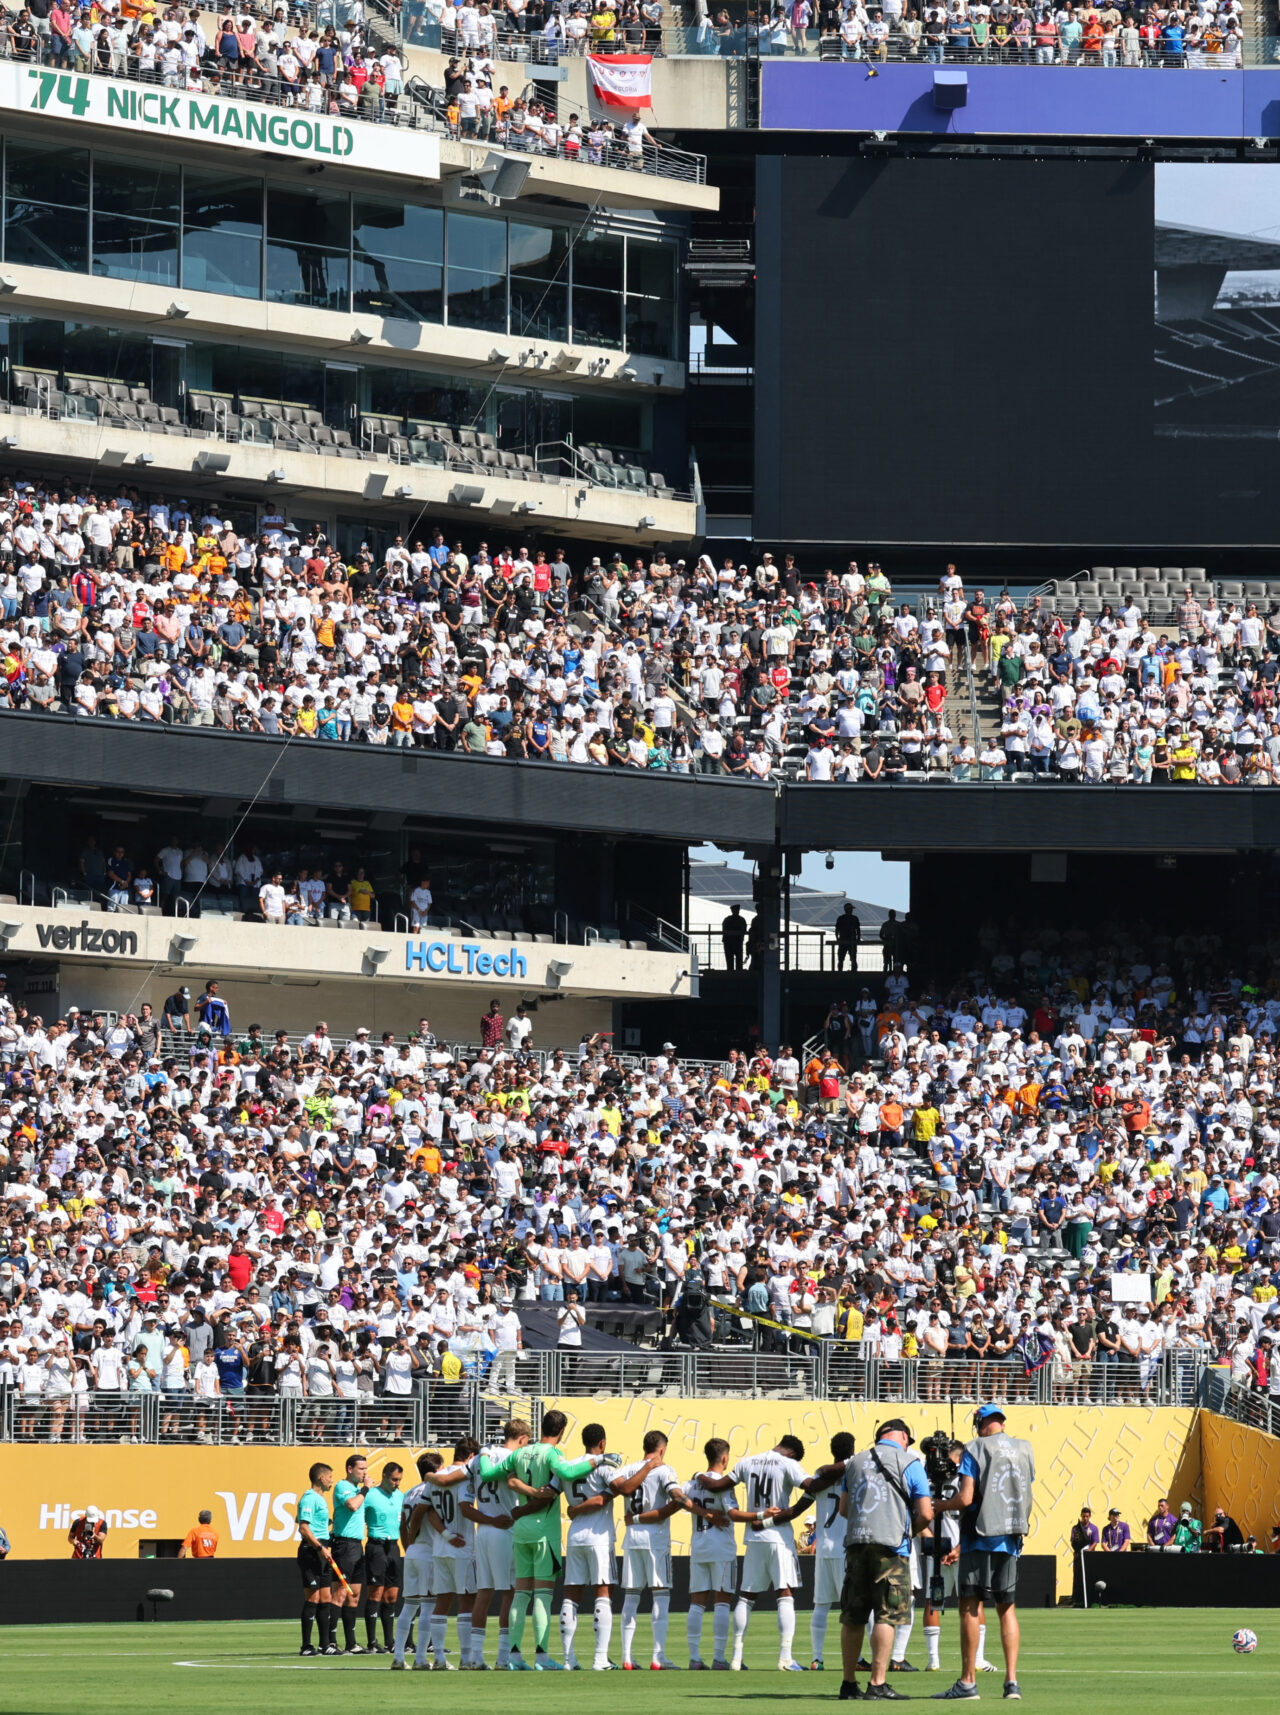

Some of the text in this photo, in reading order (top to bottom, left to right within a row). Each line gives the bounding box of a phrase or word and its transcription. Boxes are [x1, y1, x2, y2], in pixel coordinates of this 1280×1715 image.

[28, 69, 355, 157] 74 NICK MANGOLD
[36, 920, 138, 955] verizon
[405, 940, 528, 977] HCLTech
[1000, 1449, 1017, 1458] 322
[572, 1478, 595, 1503] 5
[751, 1472, 774, 1508] 14
[39, 1503, 158, 1529] Hisnse
[214, 1491, 302, 1542] VIS
[824, 1493, 840, 1528] 7
